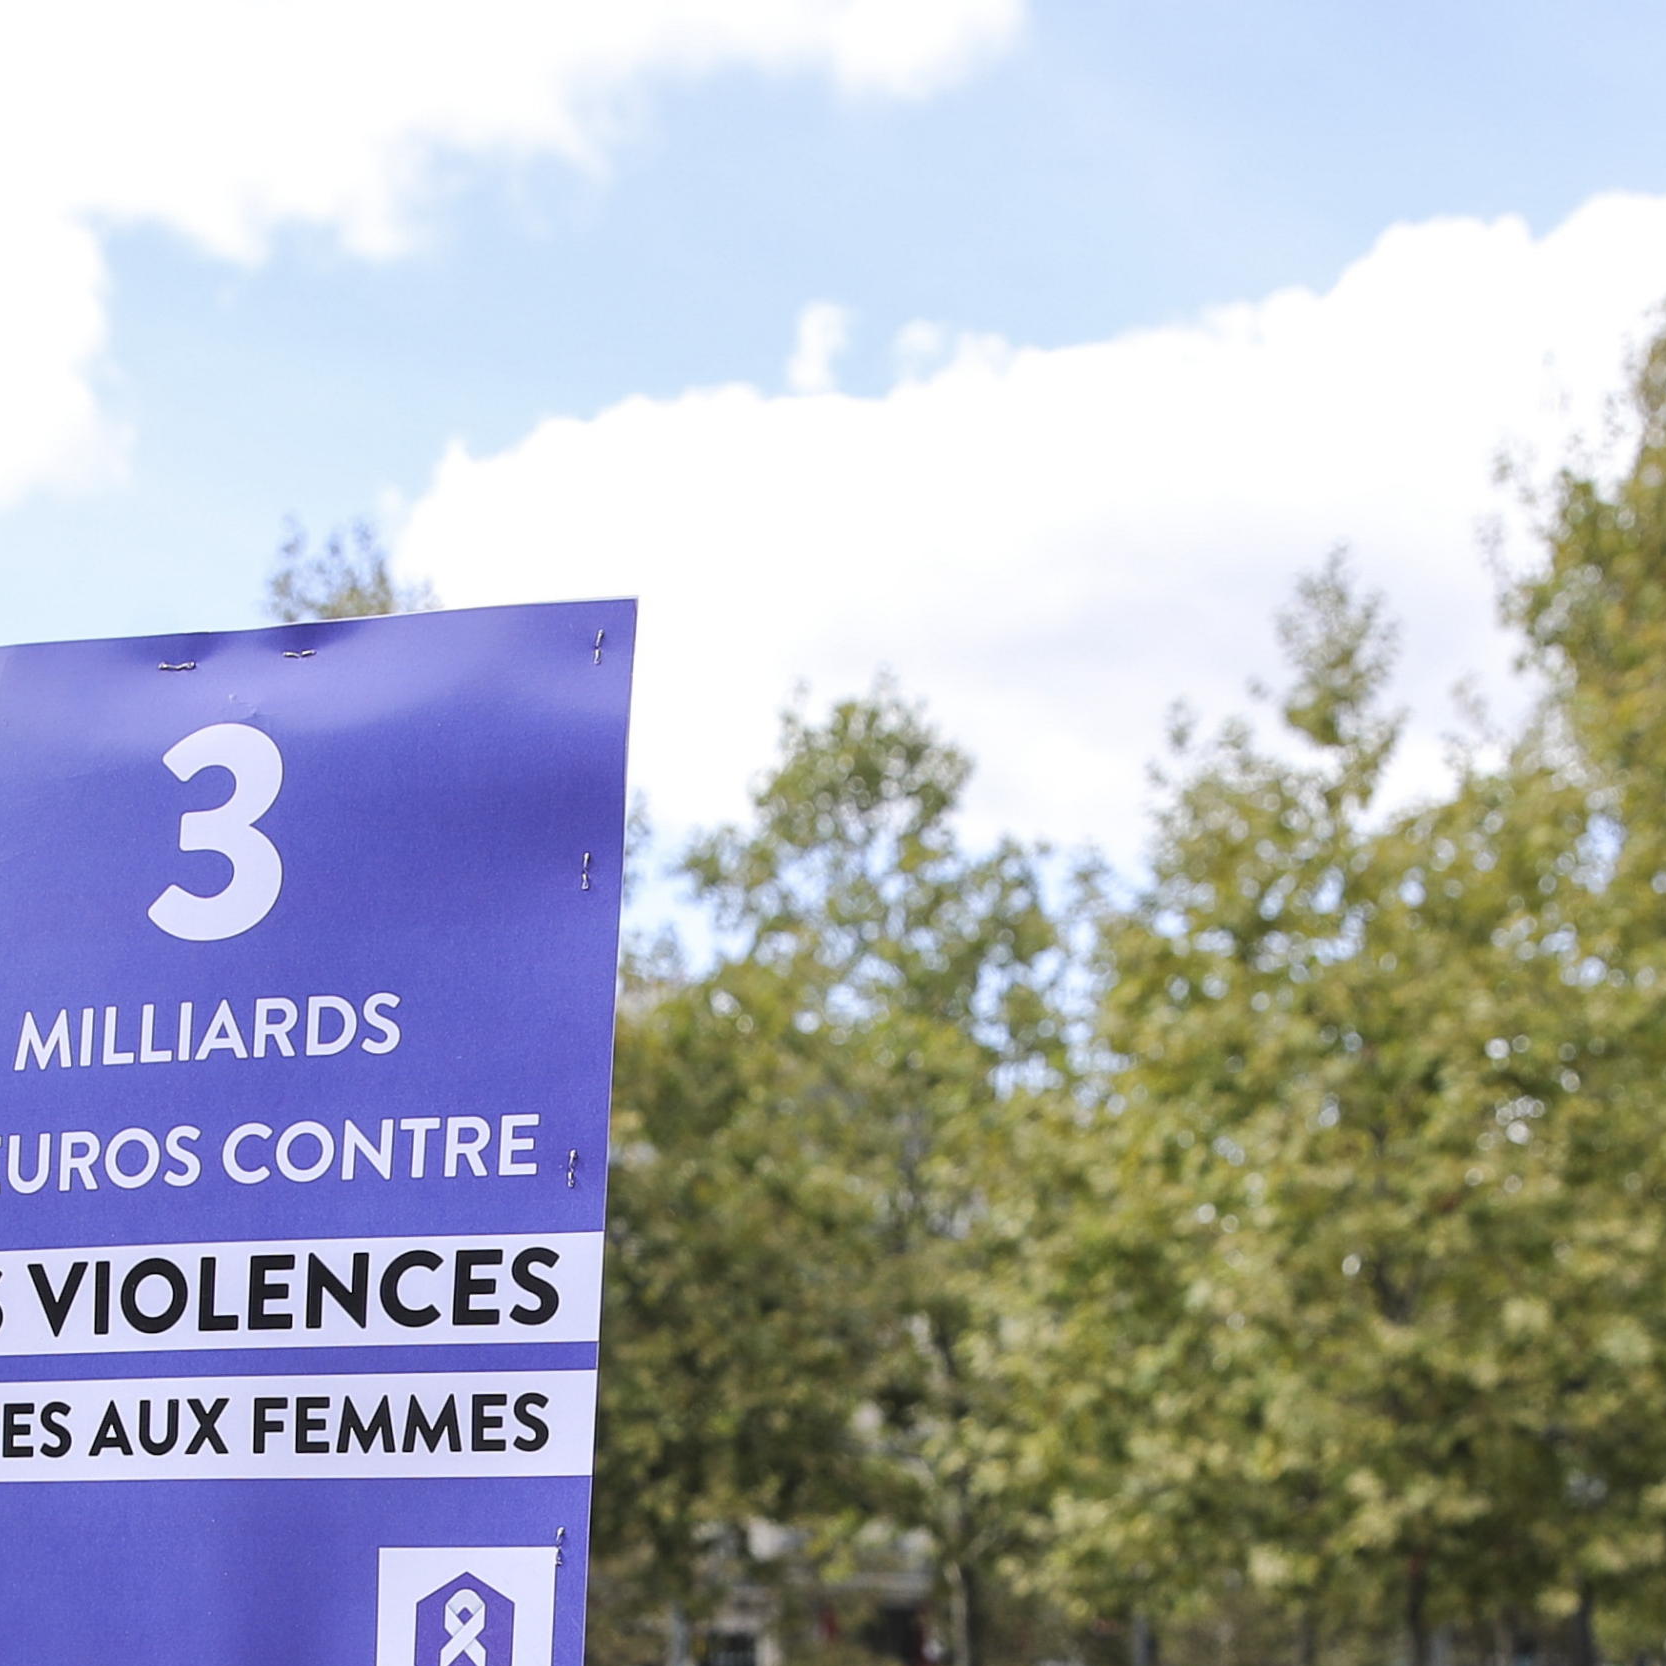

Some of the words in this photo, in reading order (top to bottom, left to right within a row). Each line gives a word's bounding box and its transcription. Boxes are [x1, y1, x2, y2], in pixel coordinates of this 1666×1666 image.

[146, 721, 284, 942] 3
[13, 991, 402, 1072] MILLIARDS
[221, 1112, 541, 1185] CONTRE
[26, 1246, 561, 1338] VIOLENCES
[87, 1397, 231, 1458] AUX
[251, 1391, 550, 1455] FEMMES
